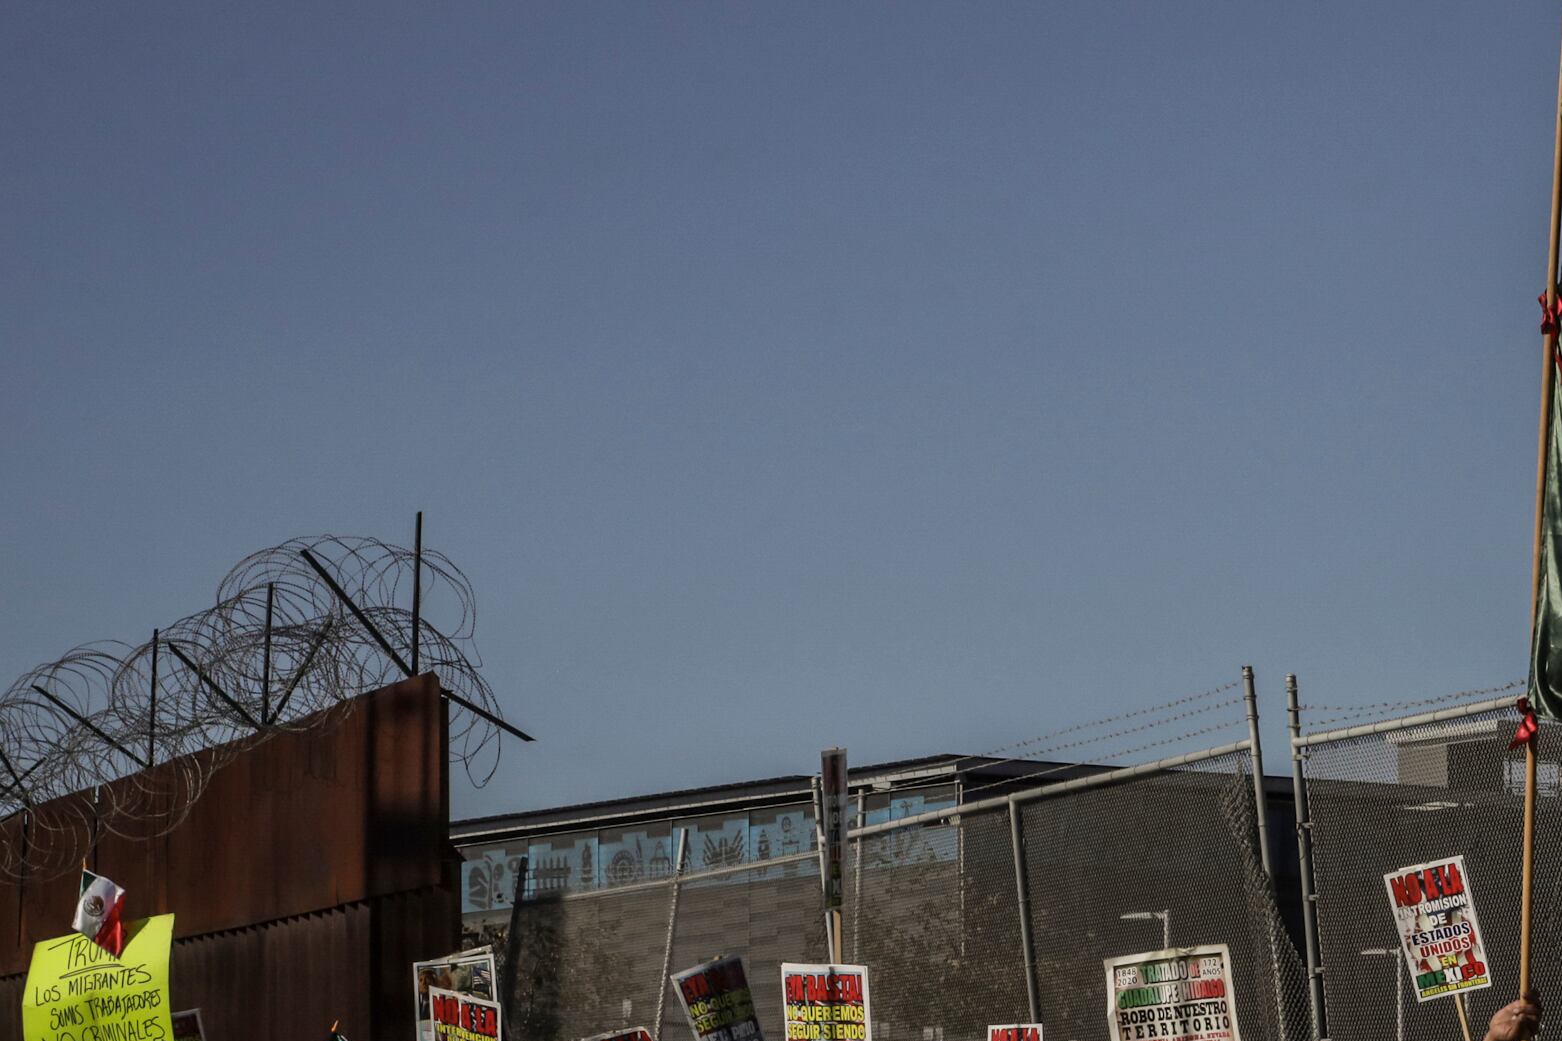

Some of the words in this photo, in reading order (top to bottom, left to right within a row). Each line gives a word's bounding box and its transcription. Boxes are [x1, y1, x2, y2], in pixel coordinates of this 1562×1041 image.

[1390, 873, 1423, 907] NO
[1439, 863, 1464, 896] LA
[1397, 894, 1467, 921] INTROMISION
[1429, 913, 1447, 926] DE
[1411, 922, 1470, 946] ESTADOS
[1420, 937, 1470, 958] UNIDOS
[1117, 968, 1136, 978] 1848
[1140, 961, 1188, 984] TRATADO
[1203, 959, 1217, 967] 172
[1441, 956, 1458, 967] EN
[35, 985, 61, 1006] LOS
[68, 964, 151, 996] MIGRANTES
[1117, 978, 1137, 986] 2020
[1416, 961, 1486, 989] MEXICO
[805, 975, 863, 1001] BASTA!
[1118, 984, 1180, 1008] GUADALUPE
[1182, 978, 1225, 1001] HIDALGO
[802, 1005, 864, 1022] QUEREMOS
[1120, 1009, 1155, 1025] ROBO
[1157, 1008, 1172, 1020] DE
[1174, 1000, 1227, 1019] NUESTRO
[788, 1024, 821, 1039] SEGUIR
[824, 1023, 865, 1039] SIENDO
[1122, 1016, 1230, 1040] TERRITORIO
